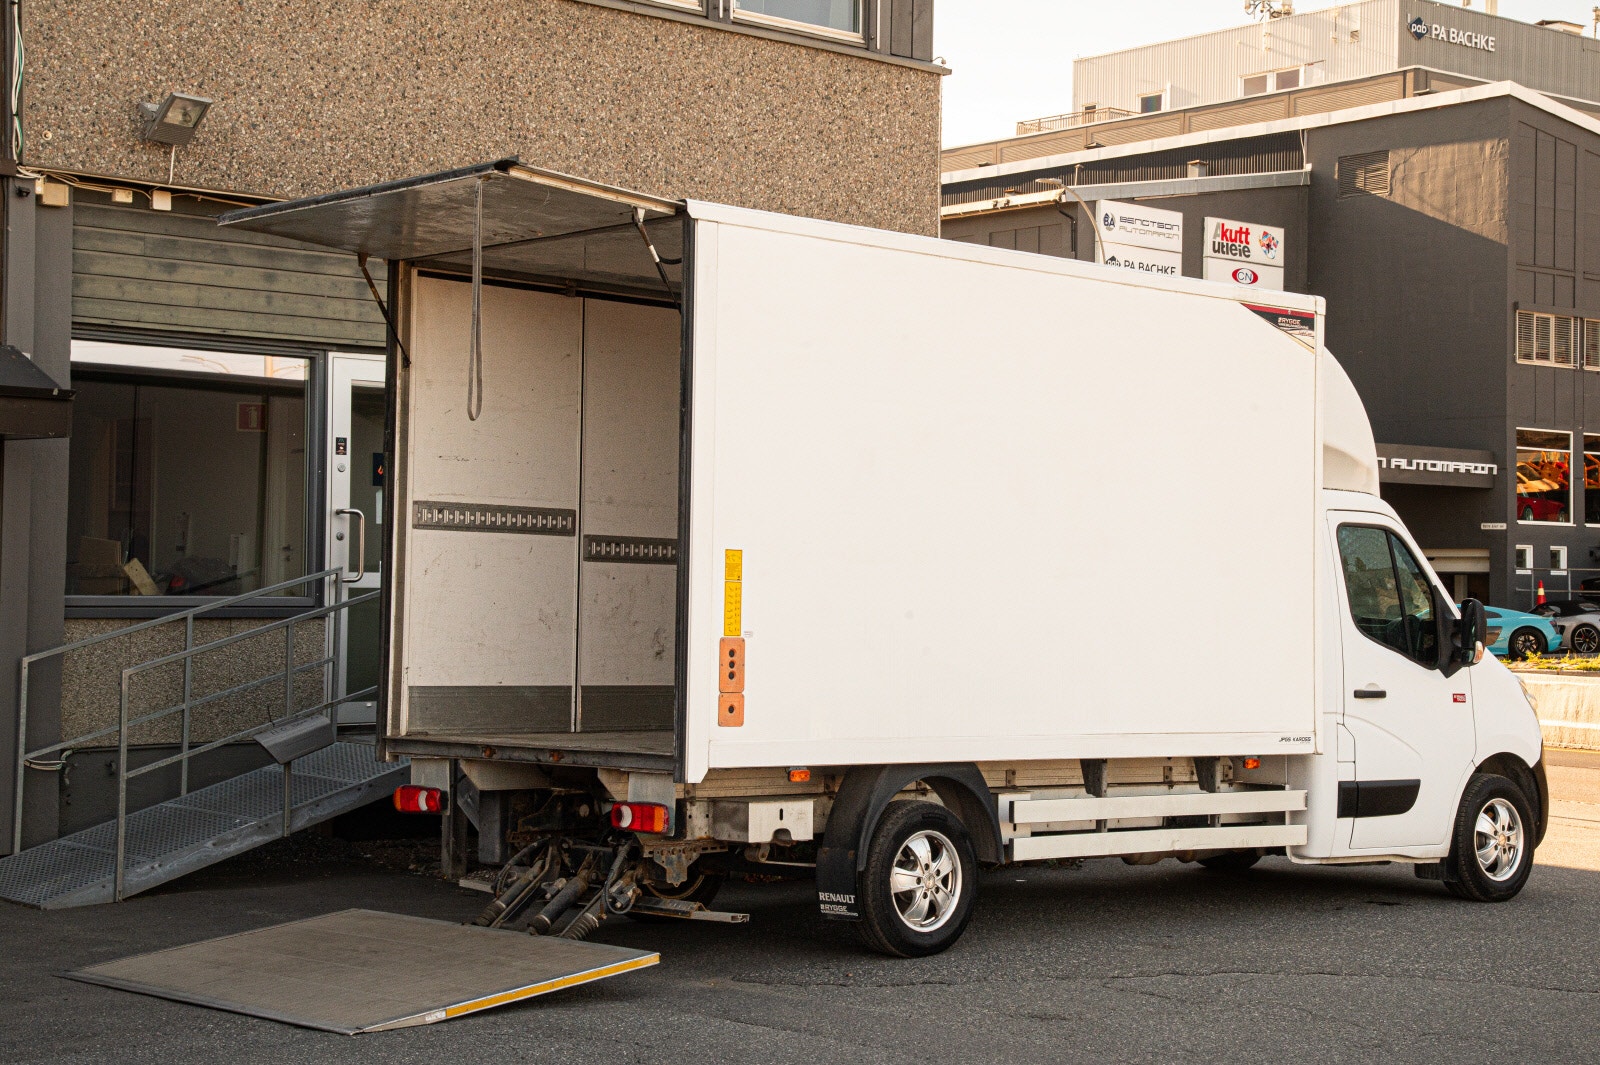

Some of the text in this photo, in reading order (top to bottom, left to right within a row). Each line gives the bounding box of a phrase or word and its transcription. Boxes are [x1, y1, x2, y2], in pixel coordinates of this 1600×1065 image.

[1411, 22, 1427, 34] pab
[1432, 24, 1496, 52] PA BACHKE
[1119, 216, 1180, 231] BENGTSON
[1119, 225, 1180, 240] AUTOMARIN
[1212, 222, 1251, 245] Akutt
[1212, 240, 1251, 258] utleie
[1237, 271, 1253, 282] CN
[1390, 458, 1498, 475] AUTOMARIN
[818, 892, 855, 904] RENAULT
